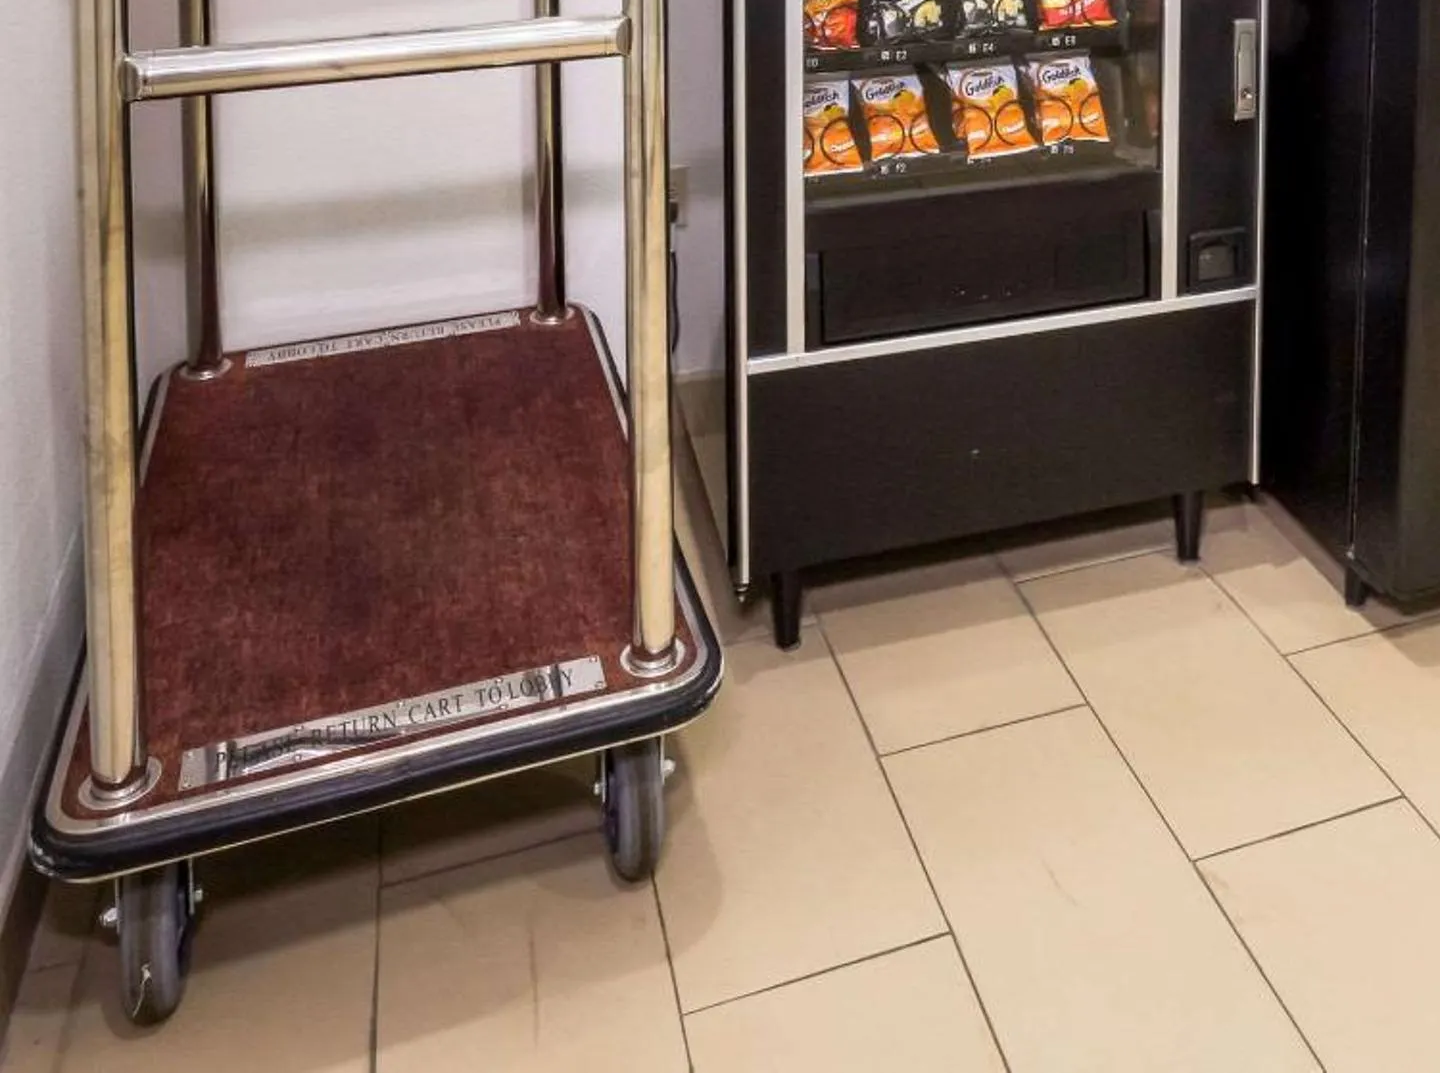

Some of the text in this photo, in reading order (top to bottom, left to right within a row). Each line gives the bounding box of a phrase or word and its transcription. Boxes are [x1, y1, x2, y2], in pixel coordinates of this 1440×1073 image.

[1042, 66, 1082, 83] Goldfish
[965, 75, 1005, 97] Goldfish
[312, 710, 398, 747] RETURN
[407, 693, 465, 725] CART
[474, 684, 502, 708] TO
